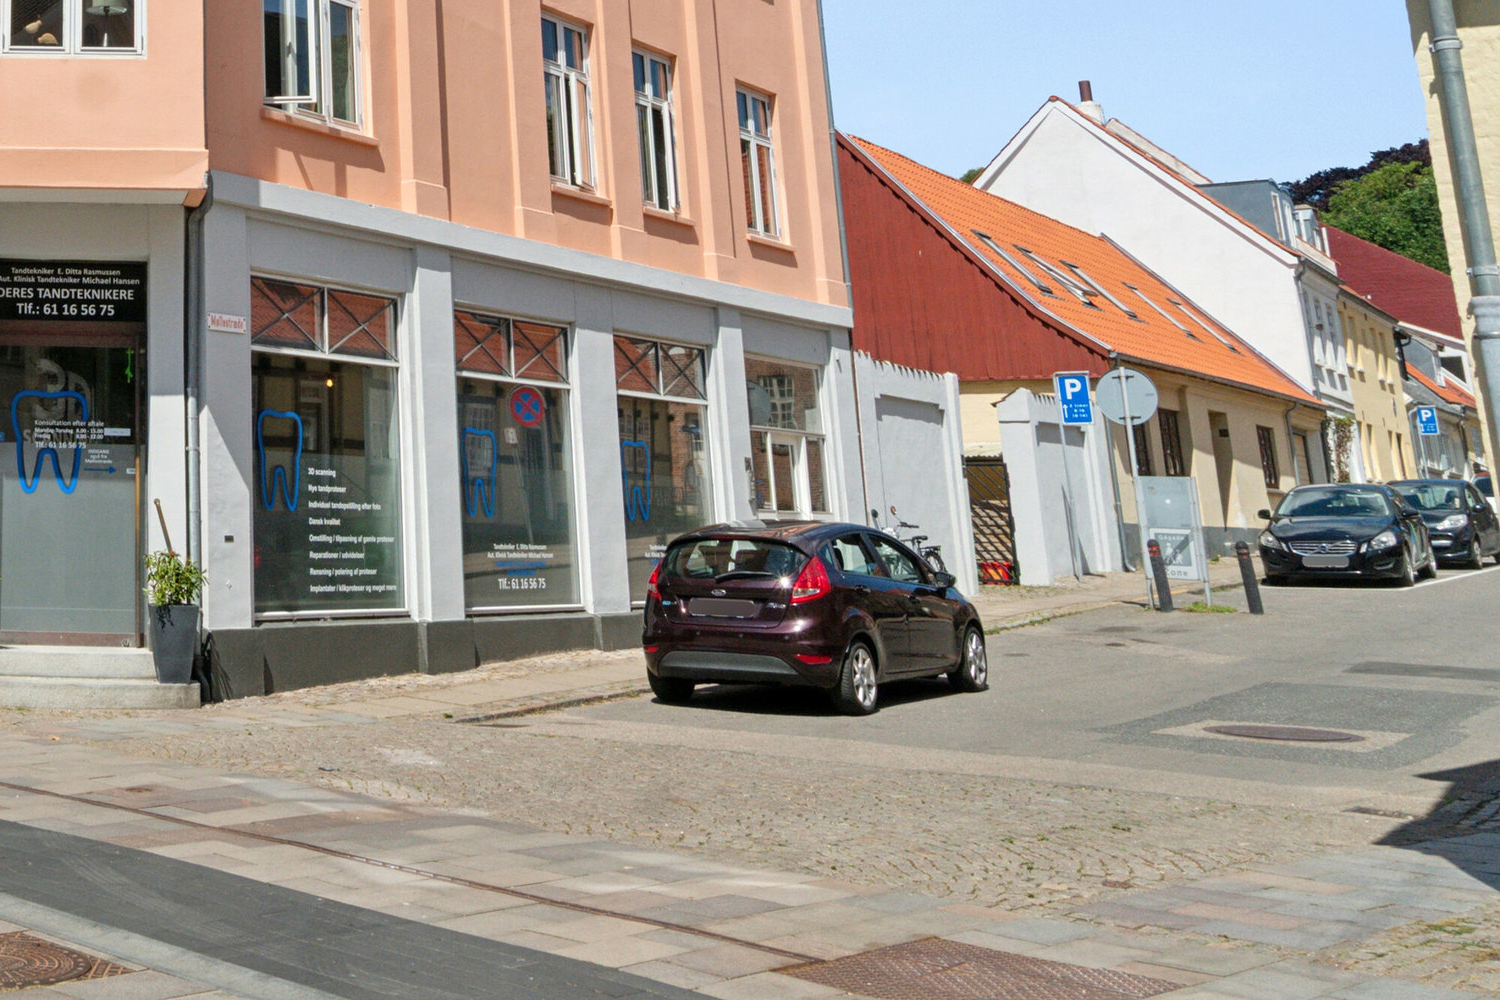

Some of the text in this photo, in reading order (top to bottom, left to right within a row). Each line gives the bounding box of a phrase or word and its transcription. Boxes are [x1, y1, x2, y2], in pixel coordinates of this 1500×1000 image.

[11, 267, 54, 275] Tandtekniker
[83, 268, 120, 276] Rasmussen
[37, 276, 80, 284] Tandtekniker
[113, 277, 140, 285] Hansen
[37, 288, 134, 300] TANDTEKNIKERE
[16, 303, 114, 316] Tlf.: 61 16 56 75
[1065, 379, 1081, 399] P
[1421, 410, 1431, 421] P
[498, 578, 546, 589] Tlf.: 61 16 56 75
